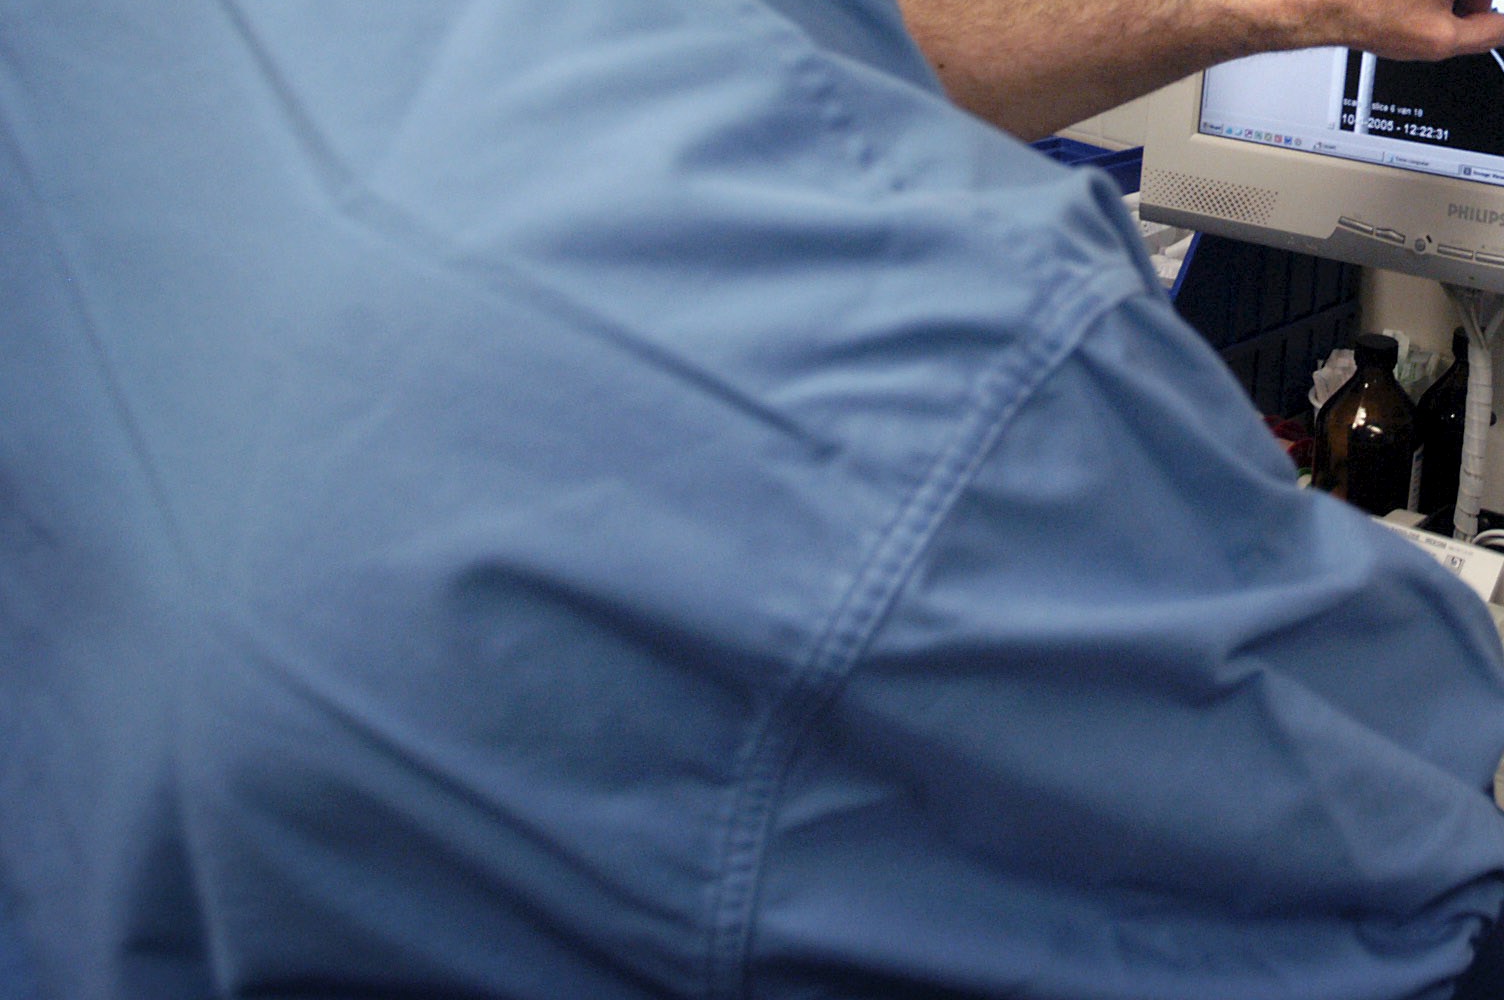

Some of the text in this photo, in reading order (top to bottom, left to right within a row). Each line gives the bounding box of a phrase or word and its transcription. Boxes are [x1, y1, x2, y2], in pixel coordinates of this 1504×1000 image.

[1371, 102, 1389, 112] slice
[1397, 107, 1411, 116] van
[1404, 123, 1449, 140] 12:22:31
